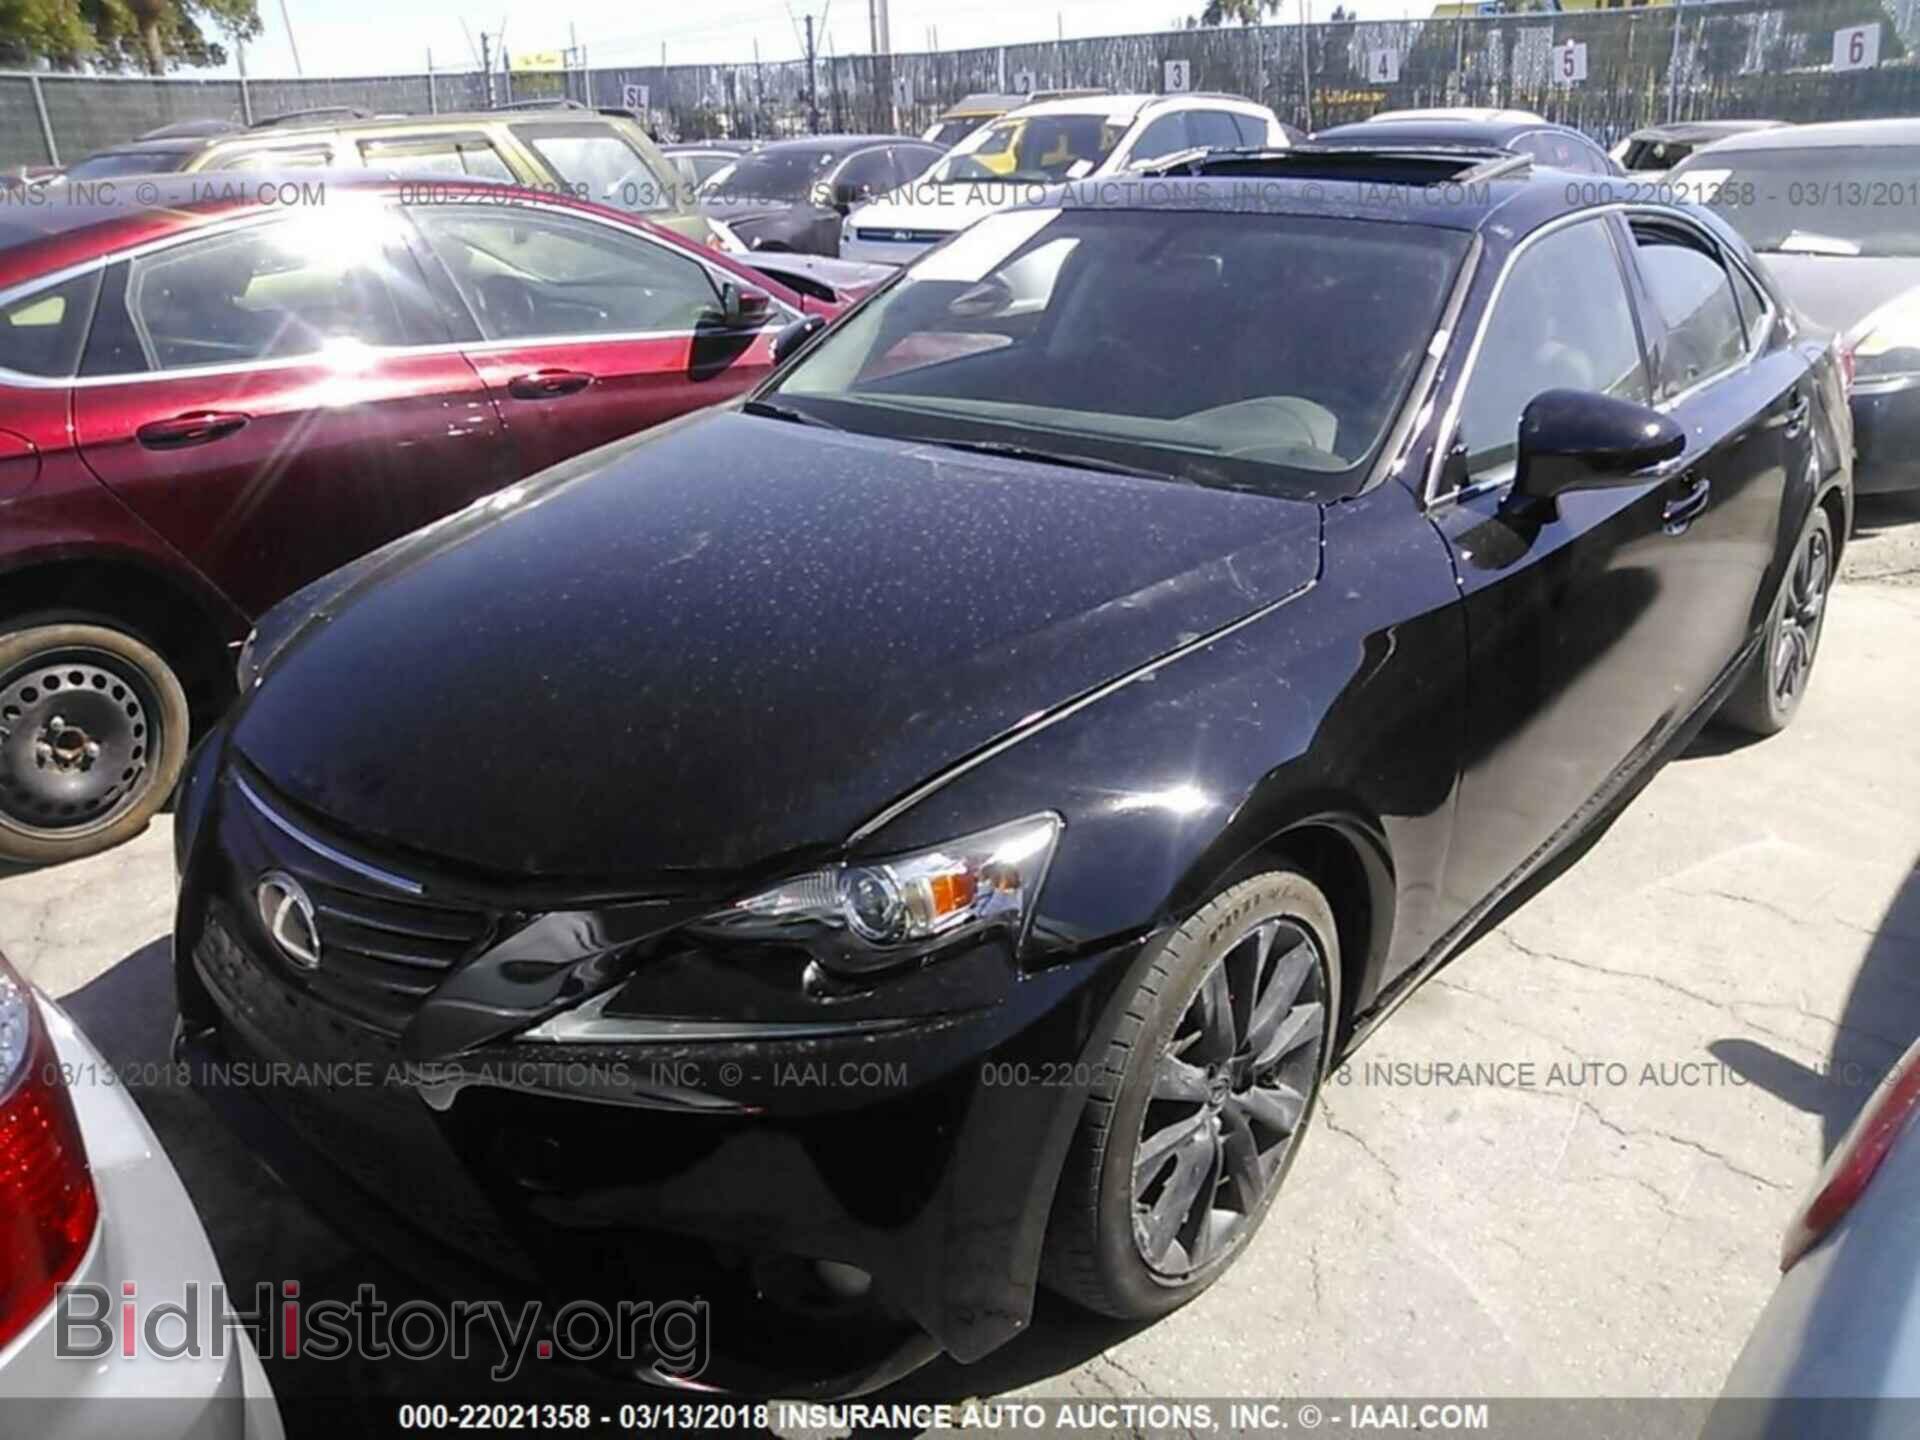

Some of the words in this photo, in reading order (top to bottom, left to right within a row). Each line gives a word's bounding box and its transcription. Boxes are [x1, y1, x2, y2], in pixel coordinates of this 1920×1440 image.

[1848, 31, 1866, 64] 6
[1172, 63, 1183, 88] 3
[1377, 53, 1388, 79] 4
[1563, 49, 1575, 77] 5
[626, 87, 646, 109] SL
